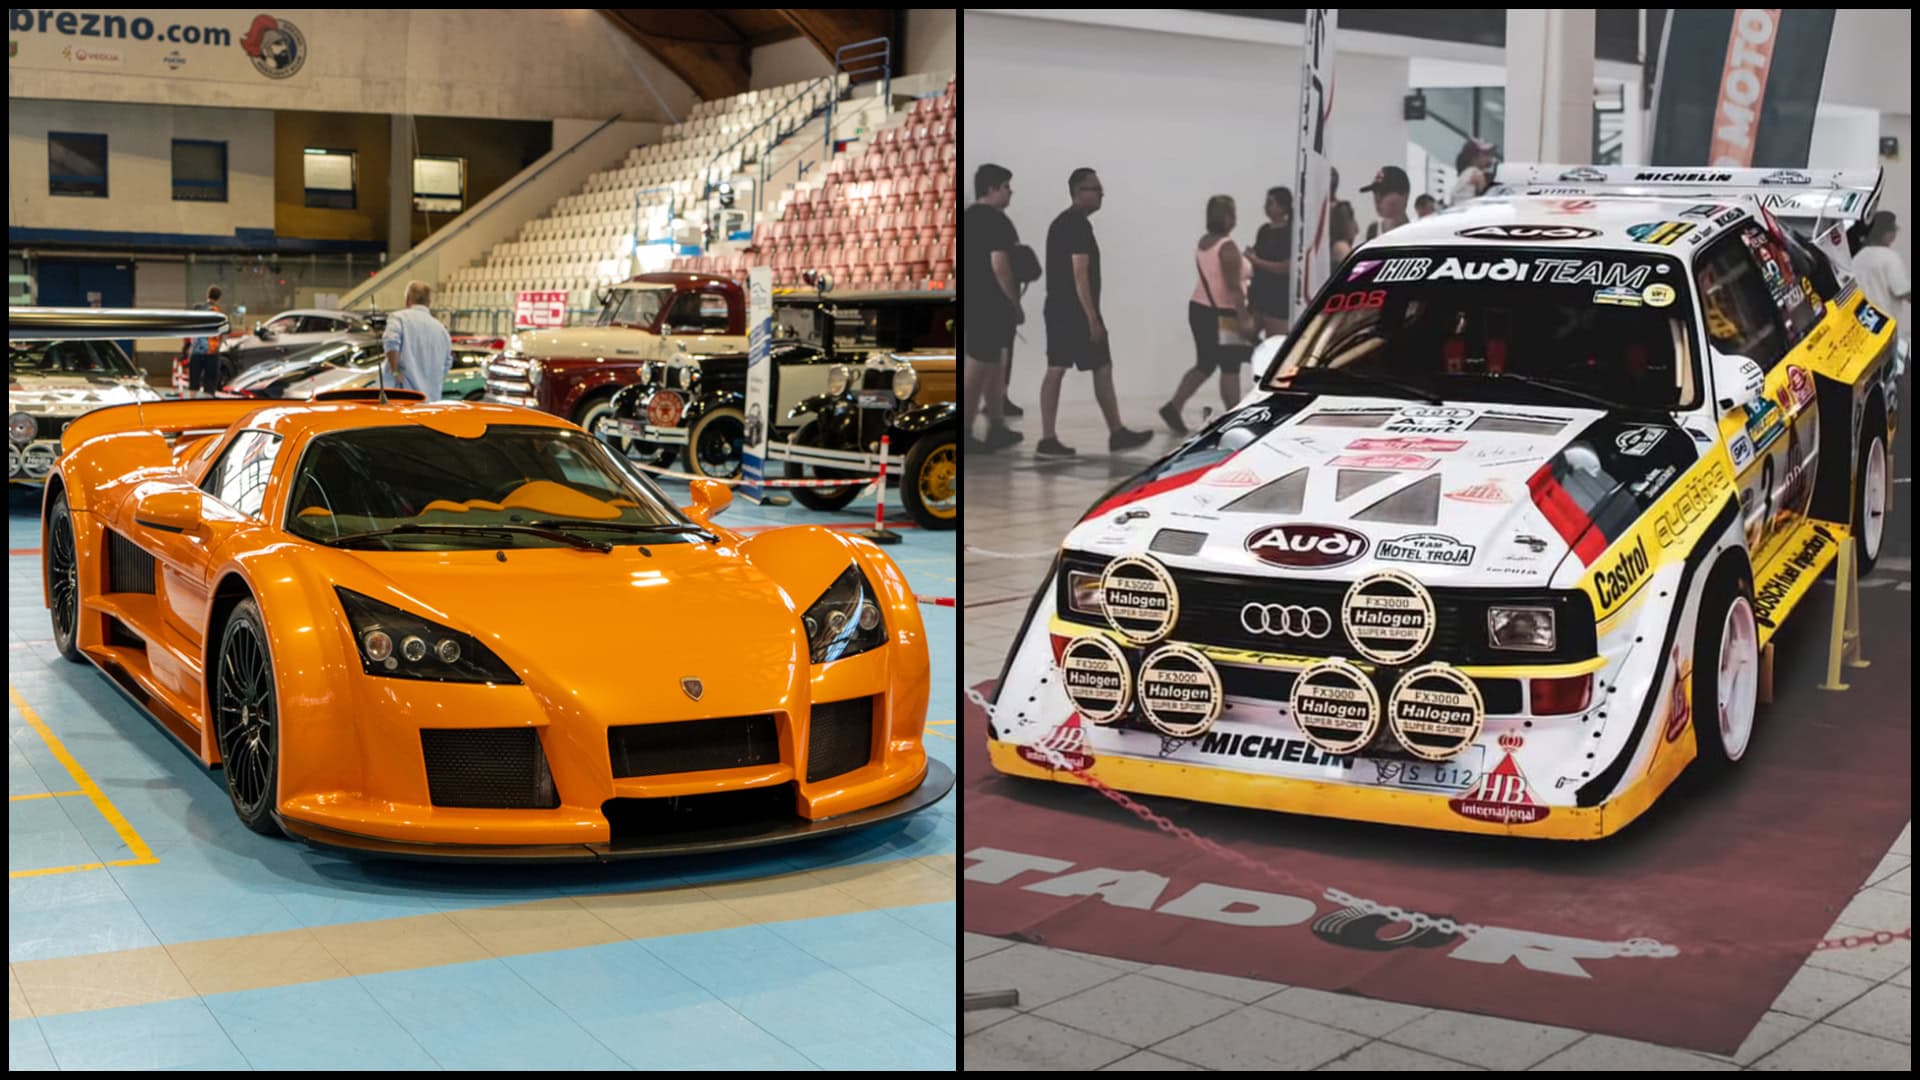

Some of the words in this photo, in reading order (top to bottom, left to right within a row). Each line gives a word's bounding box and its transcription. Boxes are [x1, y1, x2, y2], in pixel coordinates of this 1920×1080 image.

[1634, 172, 1732, 182] MICHELIN
[1427, 257, 1530, 282] Audi
[1532, 258, 1652, 288] TEAM
[515, 301, 565, 326] RED
[1250, 528, 1363, 557] Audi
[1413, 541, 1443, 549] TEAM
[1381, 543, 1423, 561] MOTEL
[1427, 549, 1470, 563] TROJA
[1593, 534, 1650, 611] Castrol
[1110, 591, 1166, 608] Halogen
[1355, 611, 1422, 627] Halogen
[1357, 628, 1387, 637] SUPER
[1069, 672, 1119, 687] Halogen
[1149, 685, 1210, 701] Halogen
[1312, 687, 1356, 699] FX3000
[1415, 692, 1460, 704] FX3000
[1302, 699, 1367, 717] Halogen
[1402, 704, 1472, 722] Halogen
[1477, 773, 1527, 802] HB
[1461, 803, 1536, 823] international
